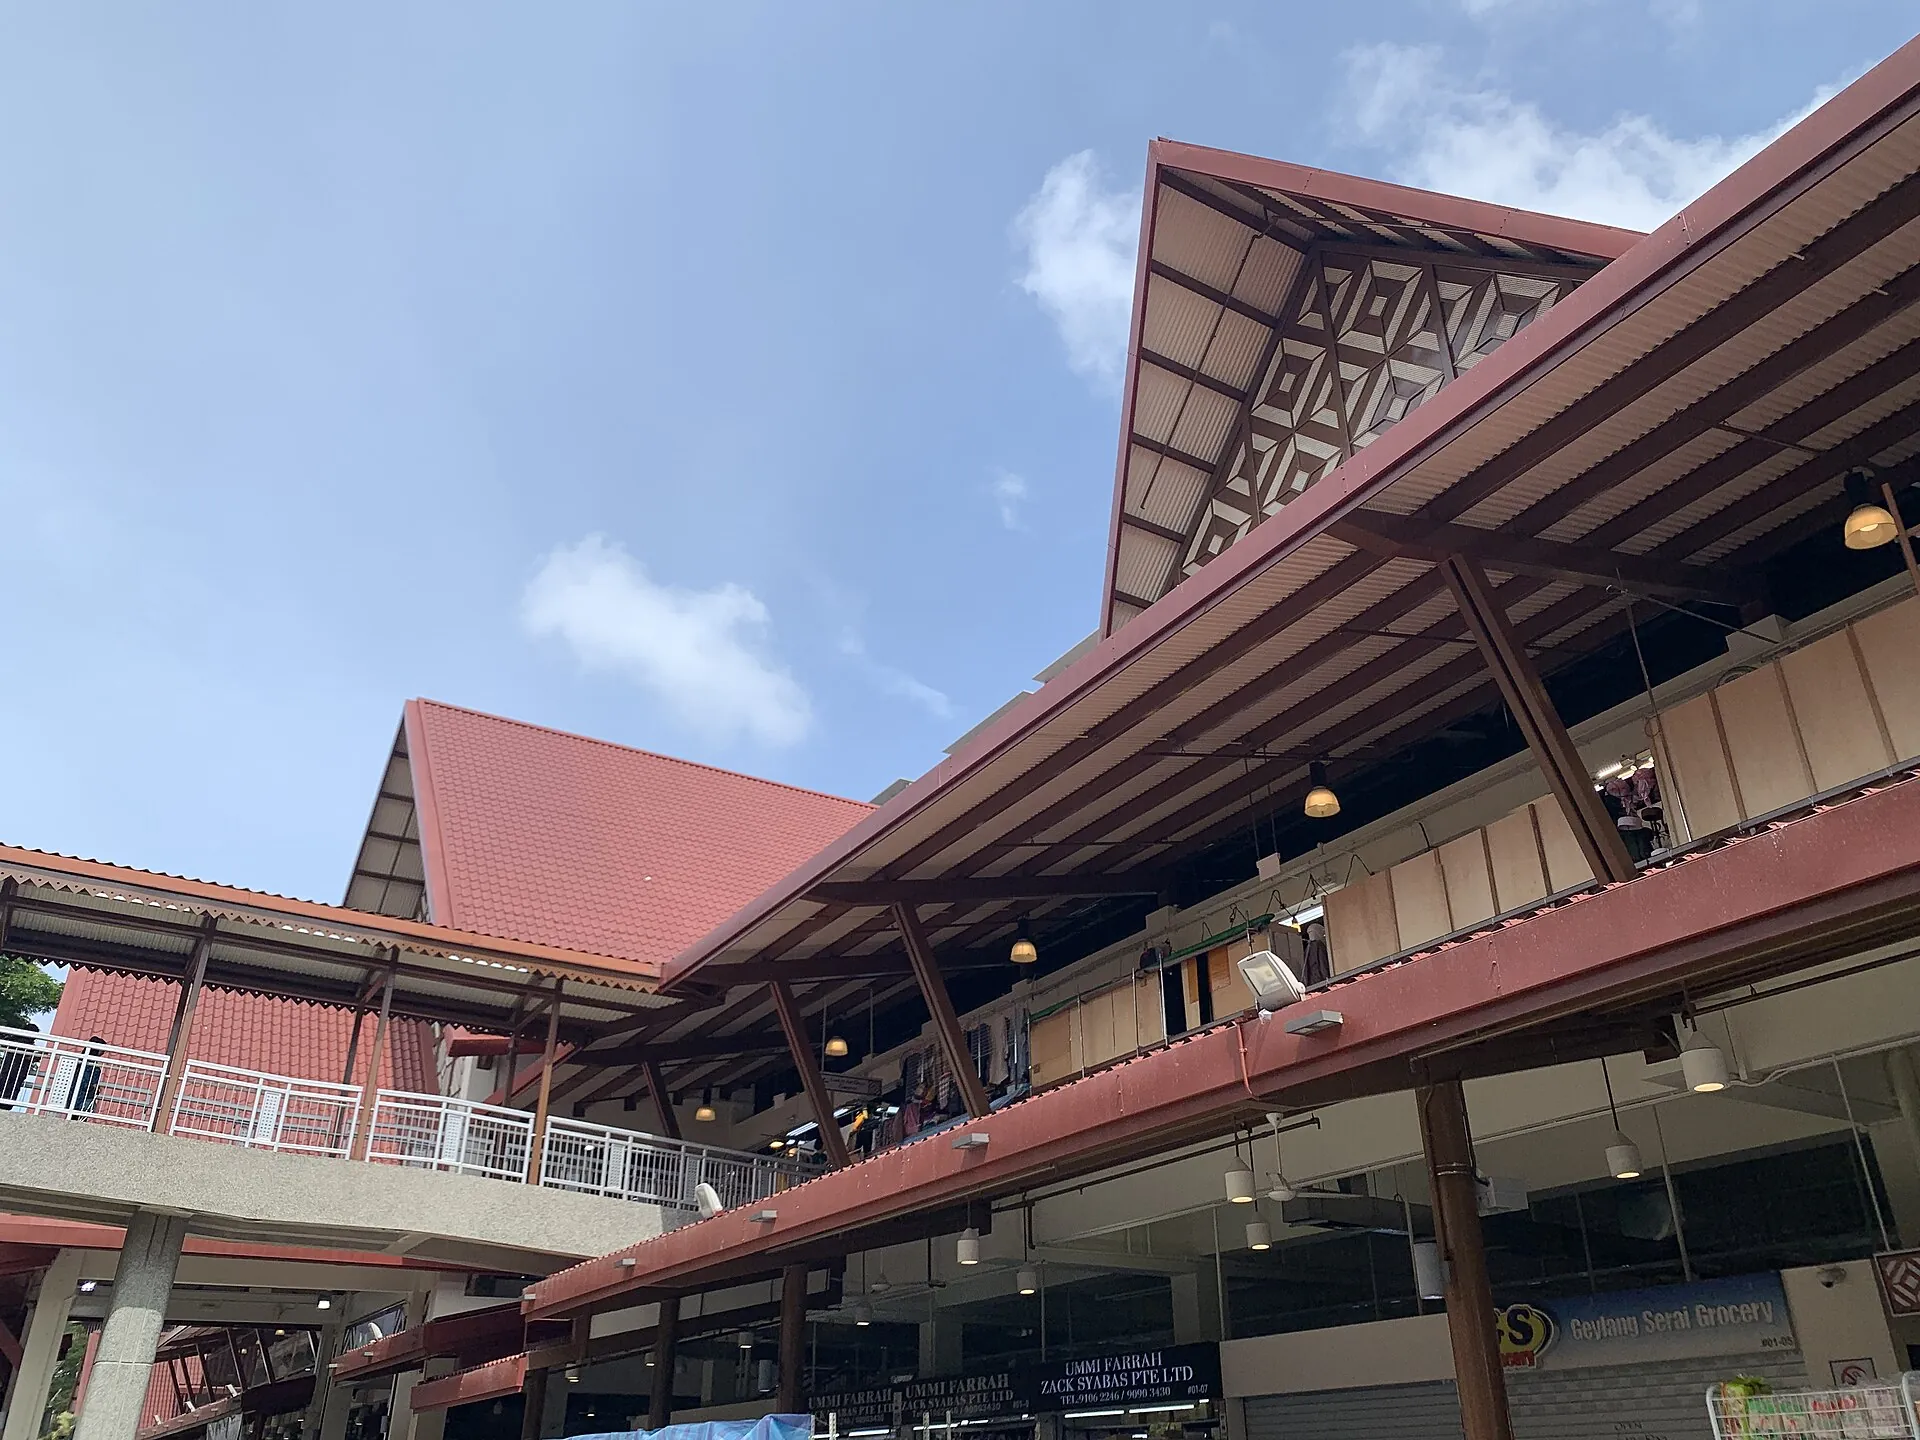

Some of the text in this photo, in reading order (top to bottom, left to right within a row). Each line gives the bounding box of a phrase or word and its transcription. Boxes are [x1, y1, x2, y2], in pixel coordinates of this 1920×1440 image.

[1496, 1309, 1533, 1346] S
[1570, 1301, 1773, 1341] Geylang Serai Grocery
[1065, 1351, 1163, 1376] UMMI FARRAH
[905, 1373, 1009, 1399] UMMI FARRAH
[1041, 1365, 1194, 1395] ZACK SYABAS PTE LTD
[808, 1387, 892, 1410] UMMI FARRAH
[928, 1394, 967, 1409] SYABAS
[968, 1391, 990, 1404] PTE
[992, 1389, 1014, 1402] LTD
[1099, 1390, 1120, 1402] 2246
[1126, 1388, 1148, 1400] 9090
[1149, 1386, 1171, 1398] 3430
